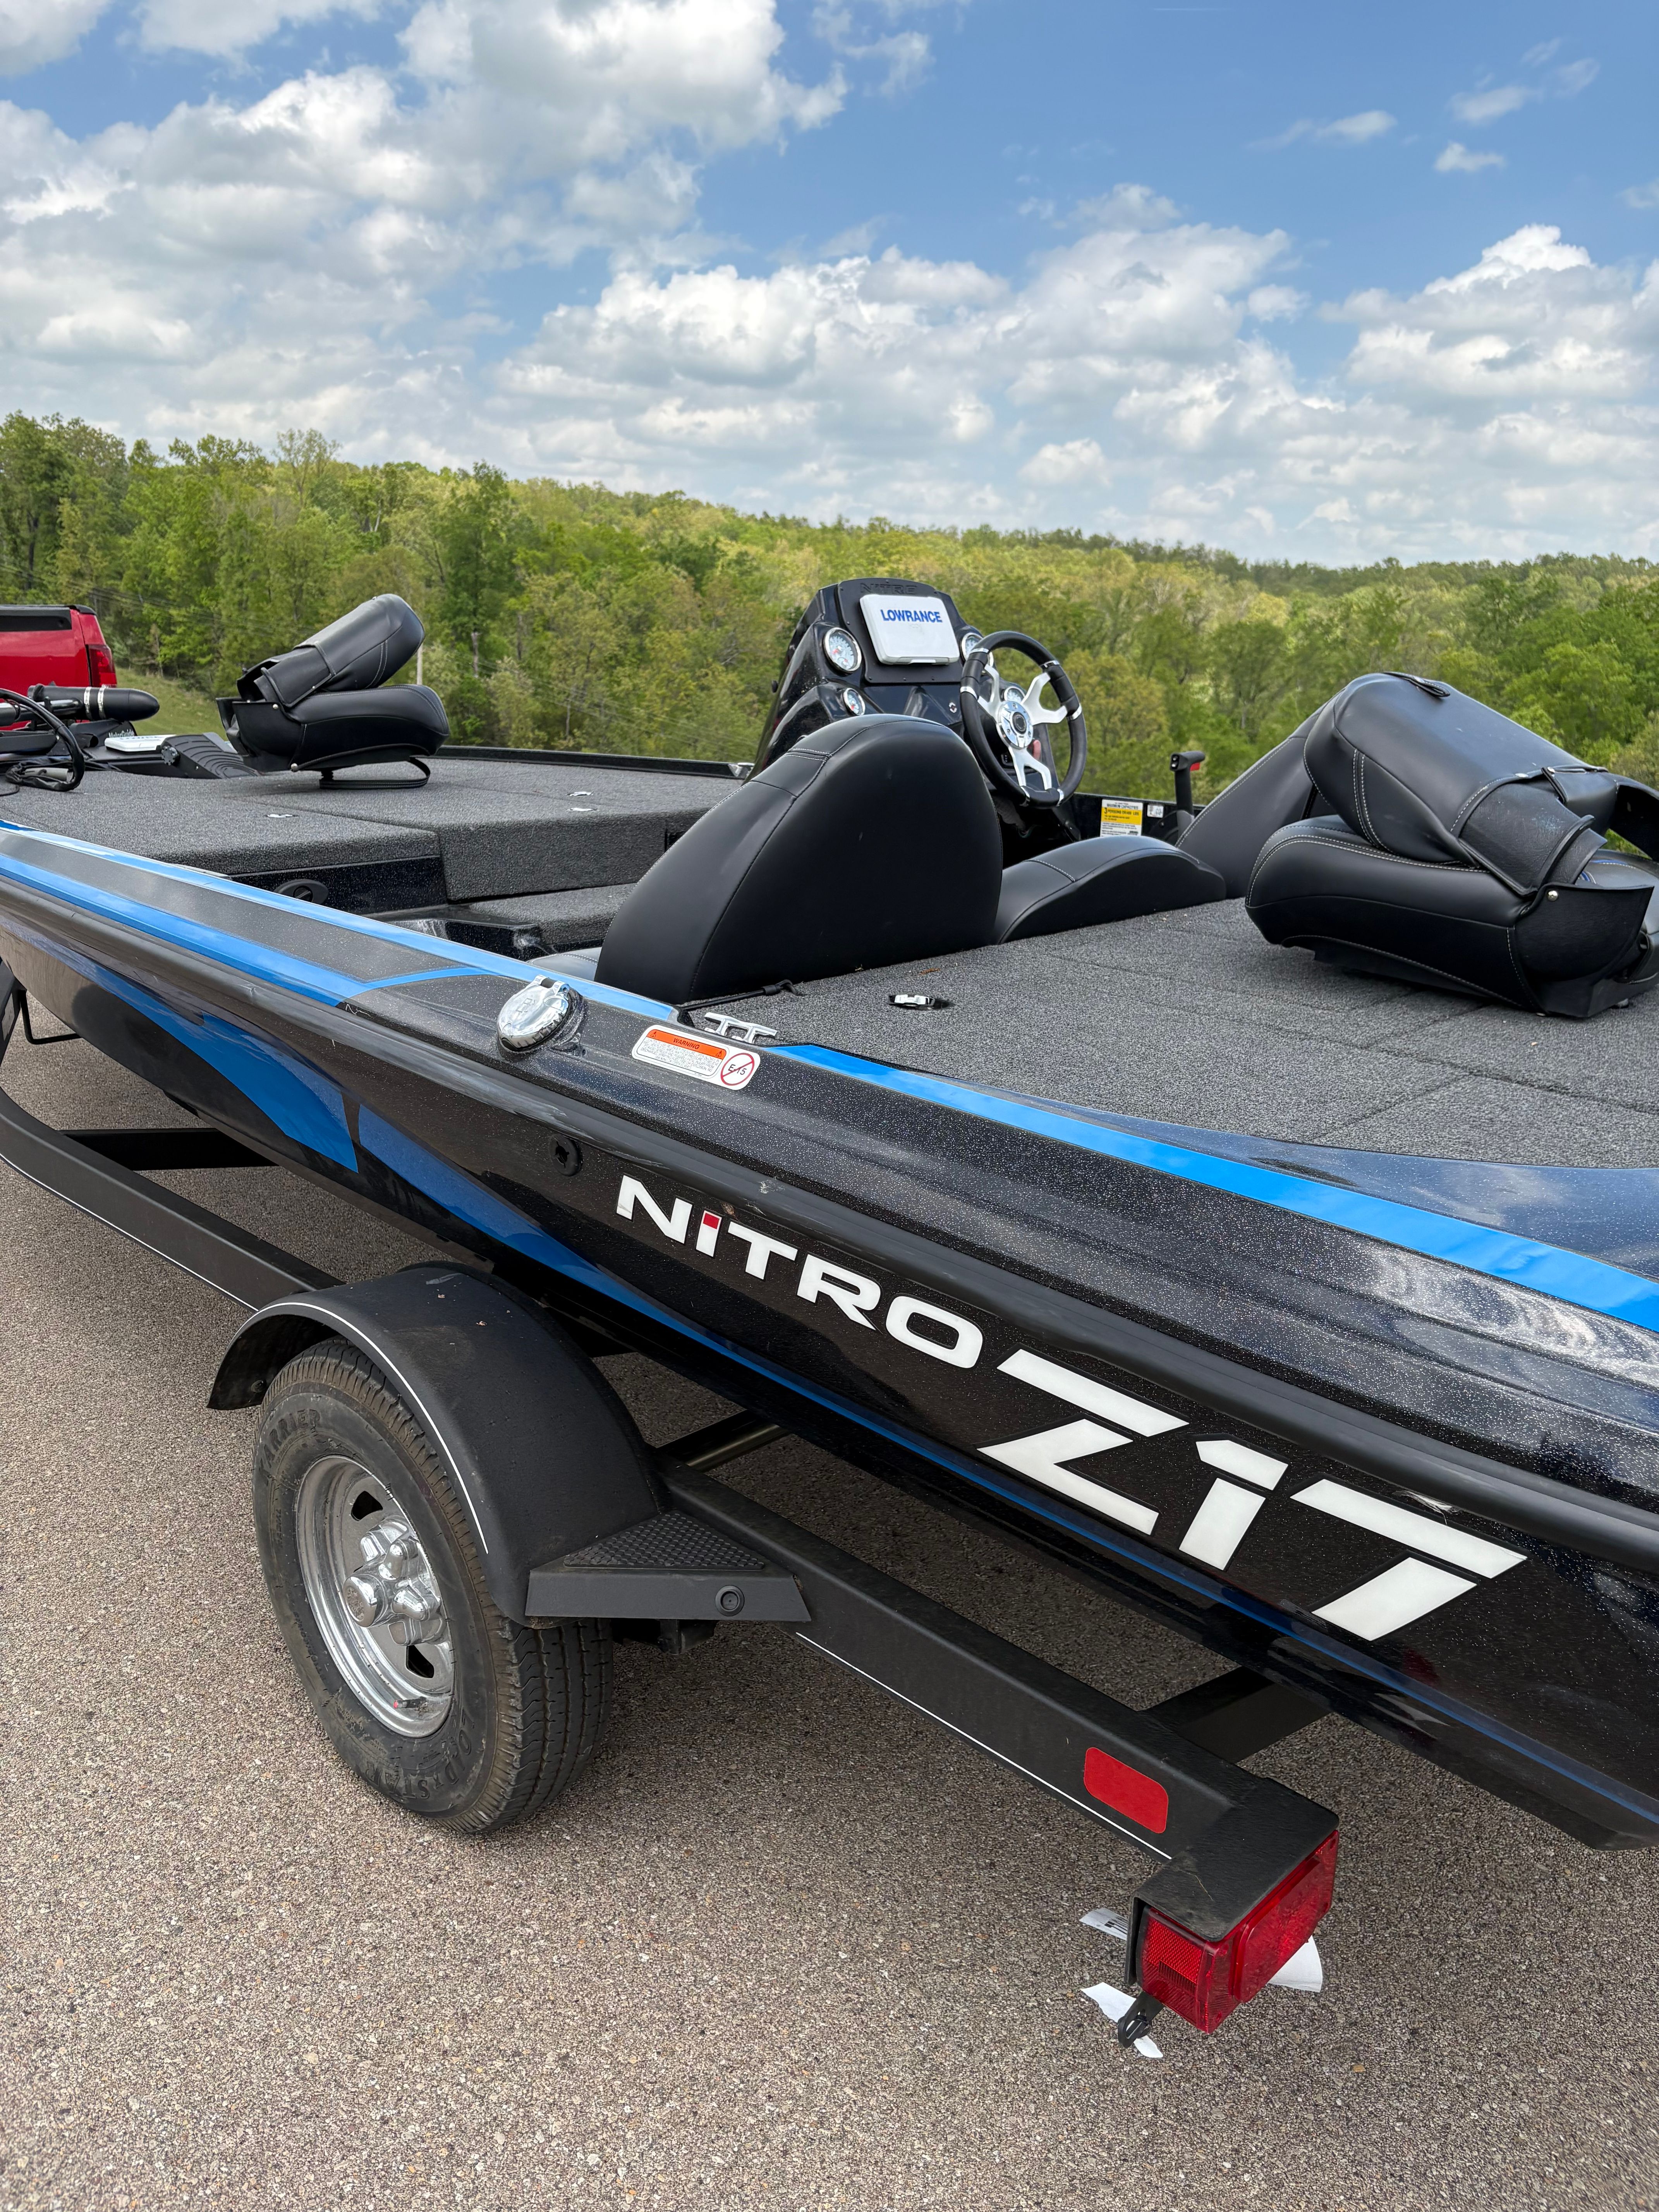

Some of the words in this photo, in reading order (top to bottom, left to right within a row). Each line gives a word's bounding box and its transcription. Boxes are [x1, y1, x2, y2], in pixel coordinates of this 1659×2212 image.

[880, 609, 943, 623] LOWRANCE
[673, 1038, 700, 1049] WARNING
[728, 1064, 747, 1075] E-15
[977, 1349, 1527, 1641] Z17
